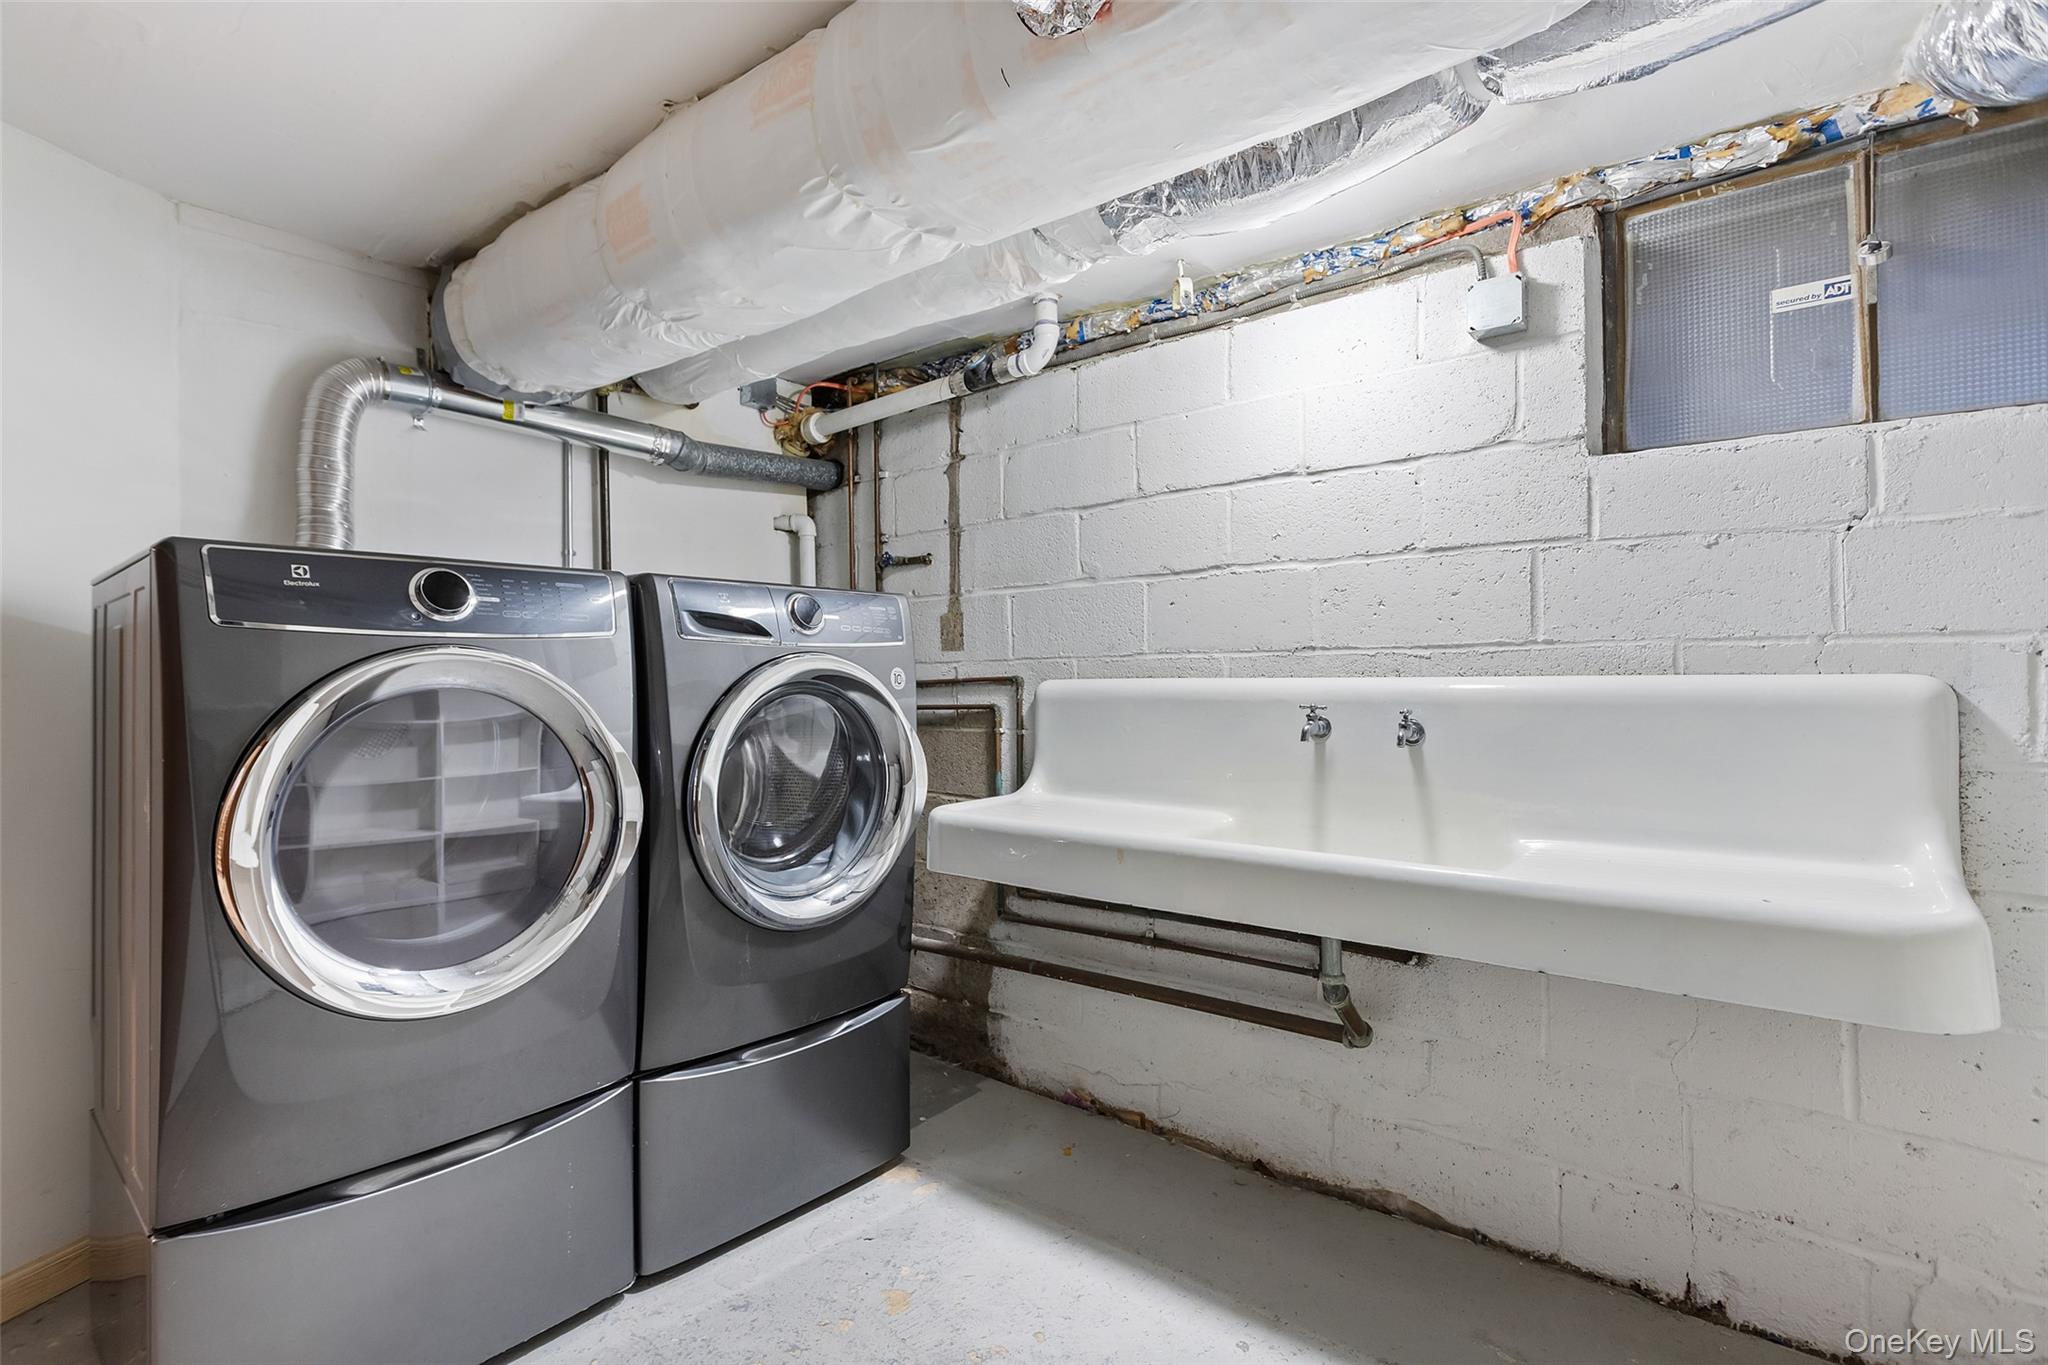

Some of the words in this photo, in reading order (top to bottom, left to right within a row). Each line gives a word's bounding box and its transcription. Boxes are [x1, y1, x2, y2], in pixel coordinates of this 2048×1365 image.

[1776, 294, 1809, 306] secured
[1811, 292, 1822, 300] by
[1824, 283, 1851, 298] ADT
[284, 579, 320, 587] Electrolux
